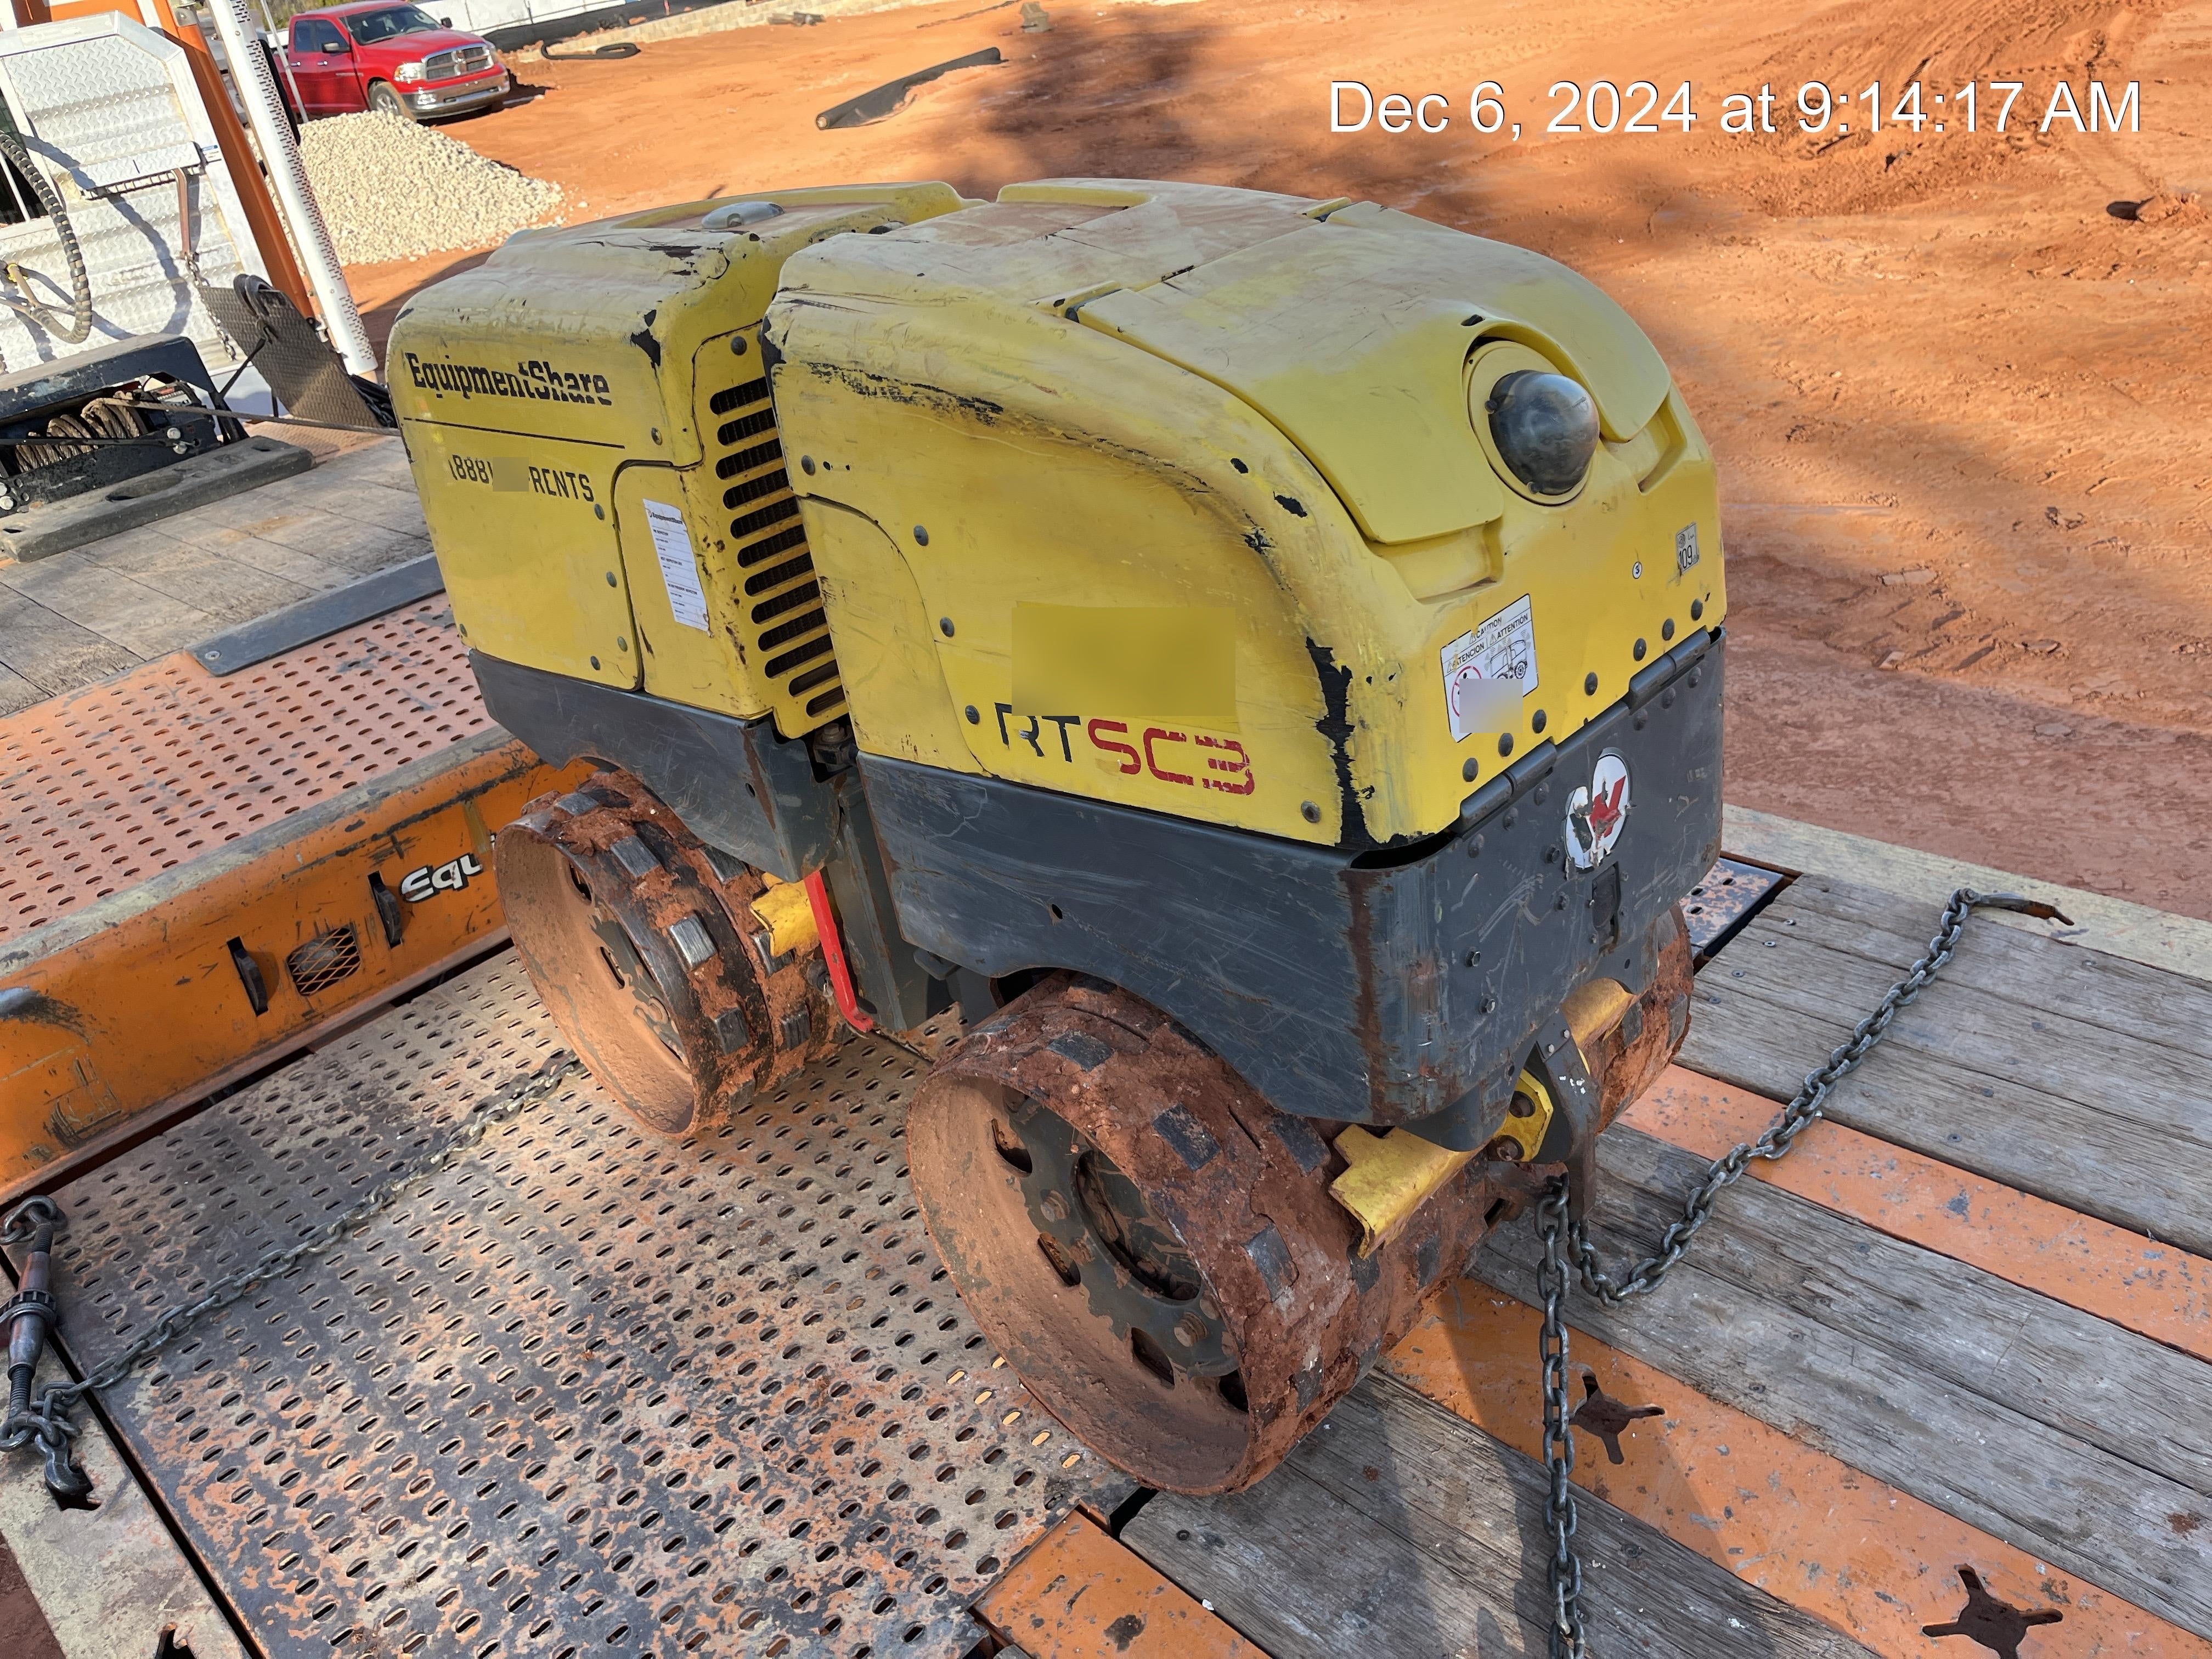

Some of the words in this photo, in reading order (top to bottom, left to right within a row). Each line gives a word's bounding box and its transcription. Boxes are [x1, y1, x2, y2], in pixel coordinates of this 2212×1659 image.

[405, 352, 612, 405] EquipmentShare
[1679, 545, 1693, 569] 109
[1497, 613, 1528, 639] ATTENTION
[401, 854, 483, 902] Equ
